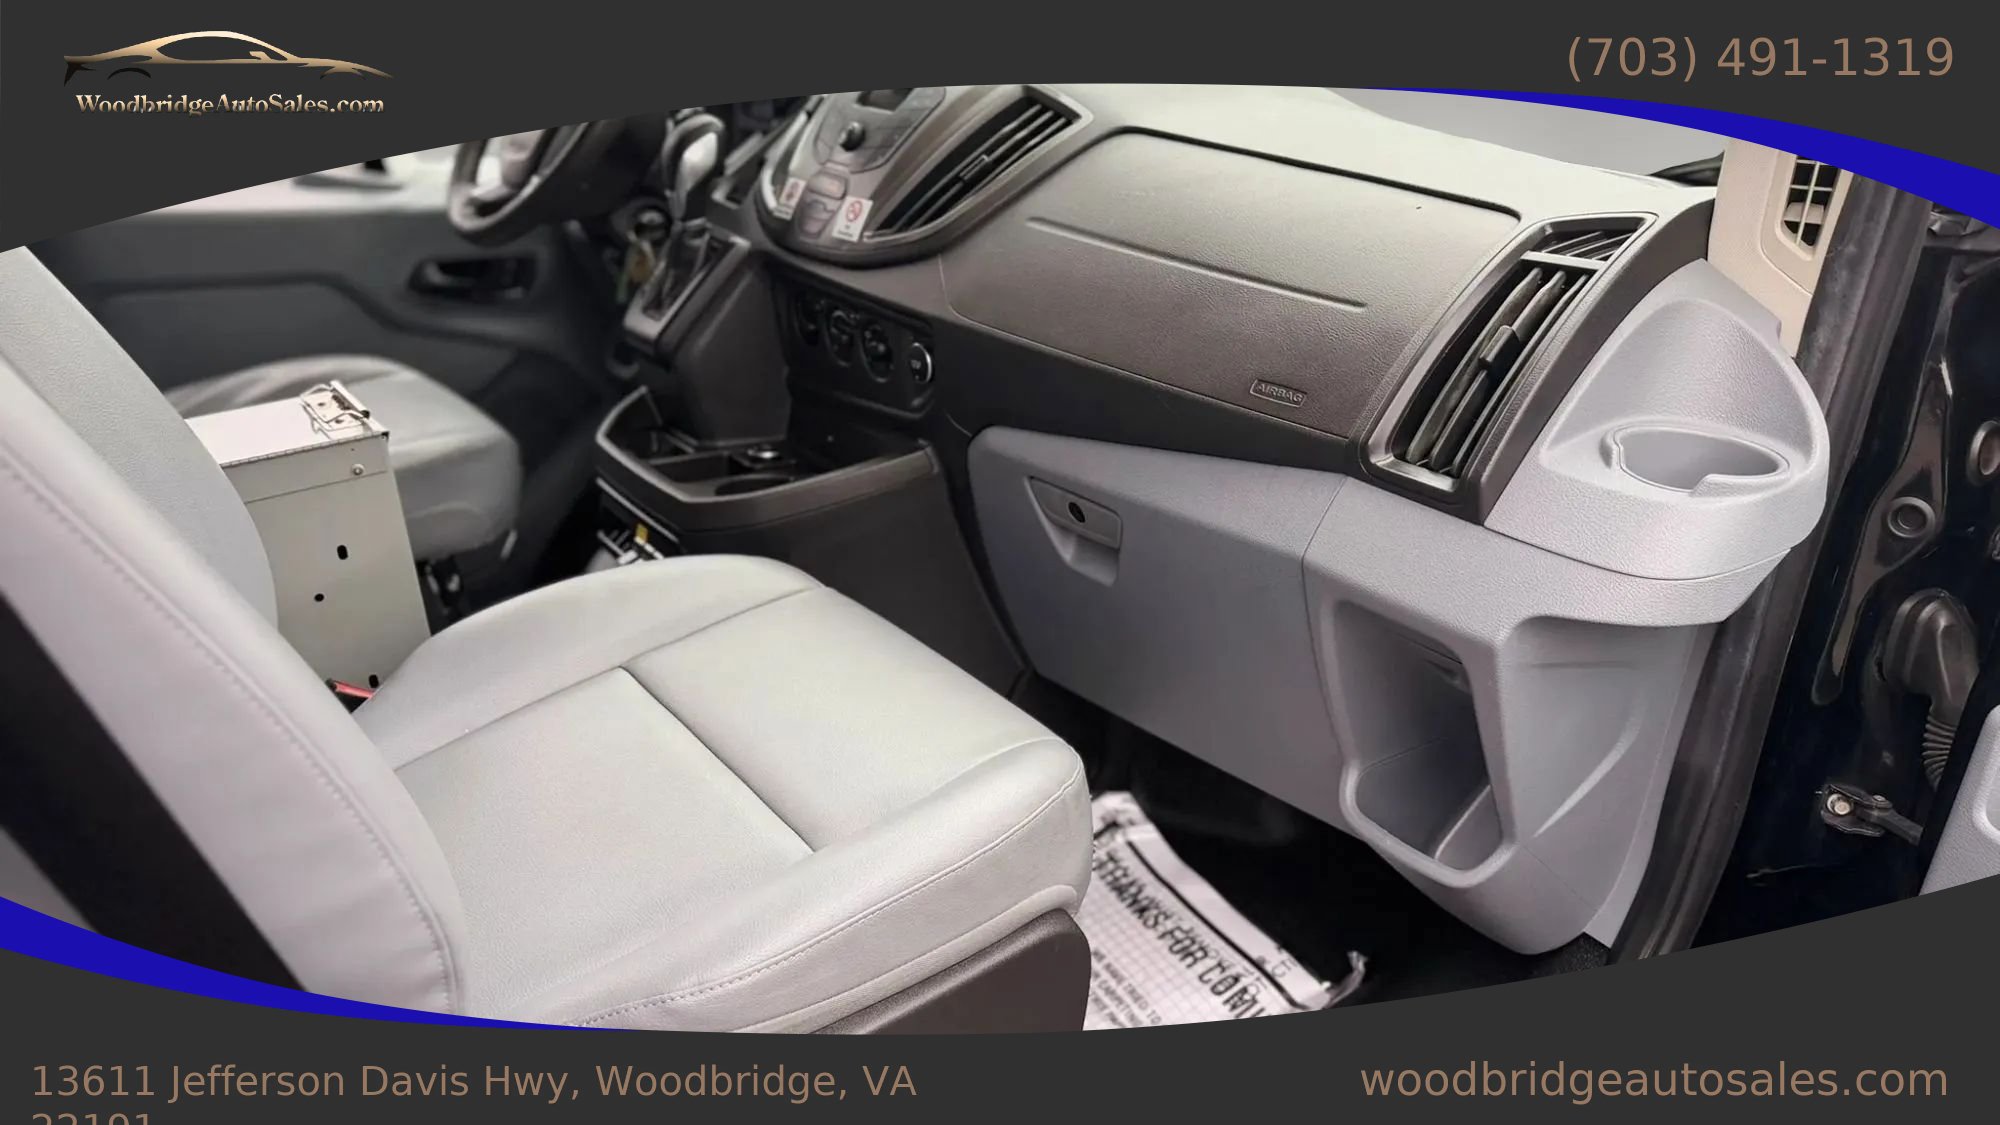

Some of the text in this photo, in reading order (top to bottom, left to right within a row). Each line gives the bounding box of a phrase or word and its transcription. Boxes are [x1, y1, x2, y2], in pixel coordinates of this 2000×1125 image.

[1258, 383, 1303, 403] AIRBAG
[1092, 851, 1170, 929] THANKS
[1158, 926, 1208, 968] FOR
